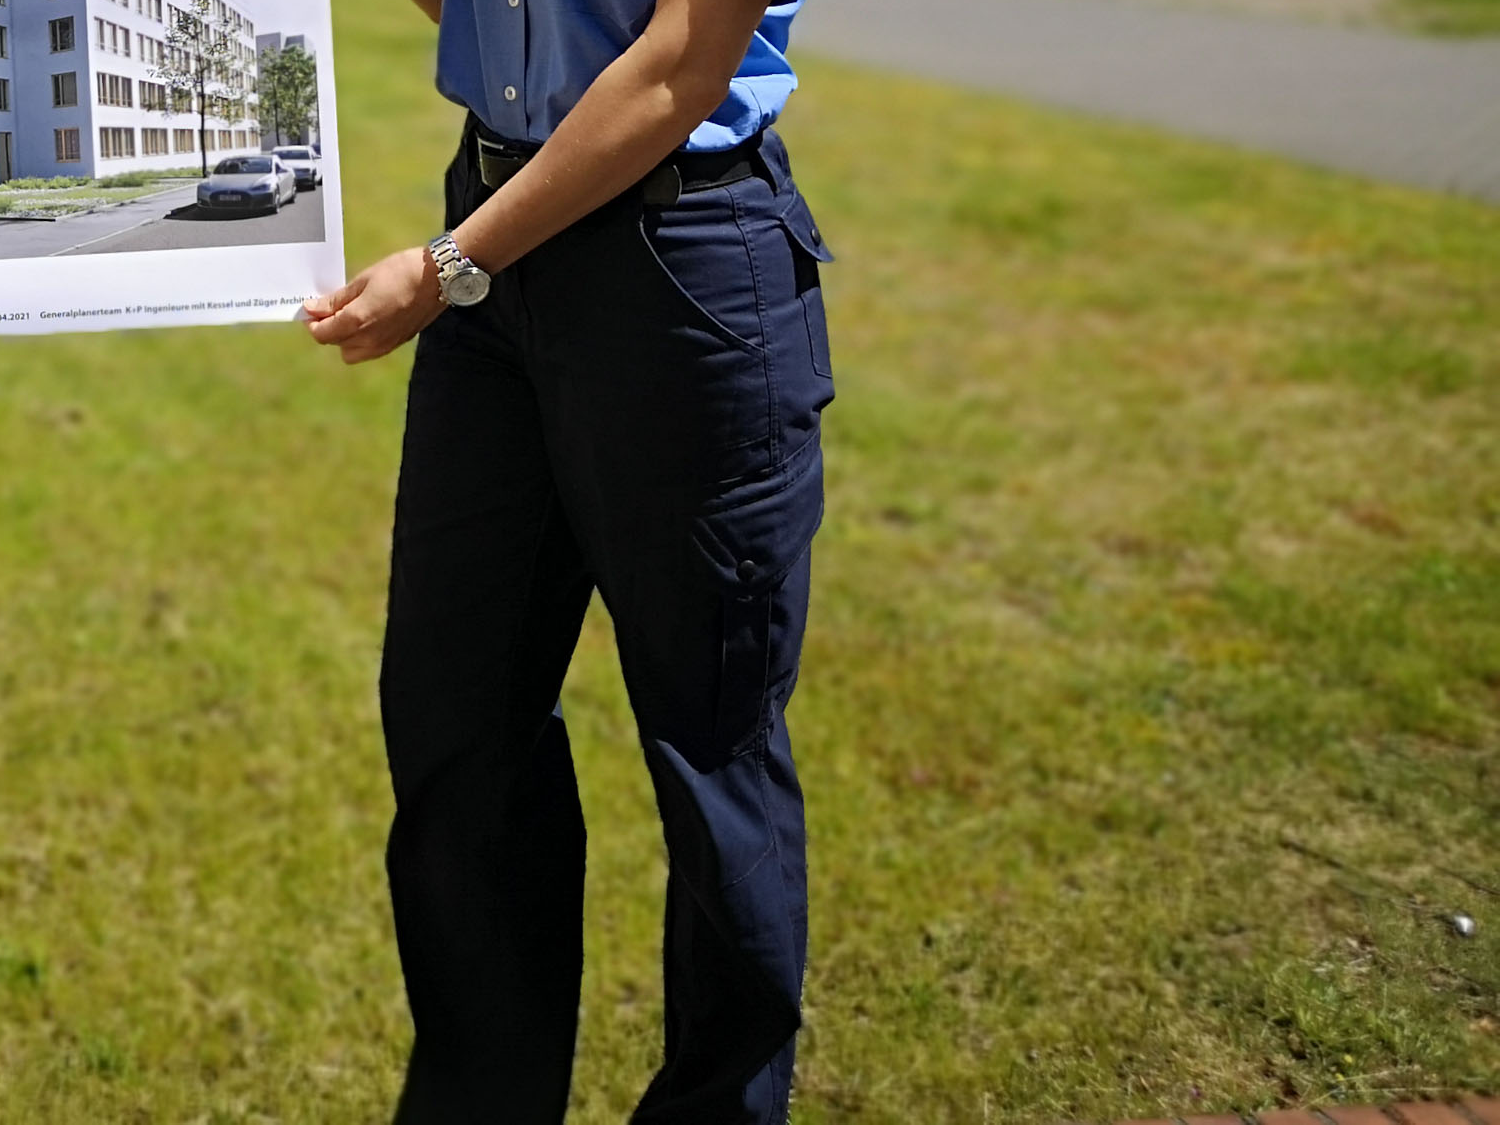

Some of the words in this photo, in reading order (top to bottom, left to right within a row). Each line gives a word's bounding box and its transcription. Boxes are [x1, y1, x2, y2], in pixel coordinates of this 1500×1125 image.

[40, 308, 122, 319] Generalplanerteam
[144, 303, 189, 315] Ingenieure
[191, 301, 205, 310] mit
[207, 299, 233, 310] Kessel
[235, 298, 252, 307] und
